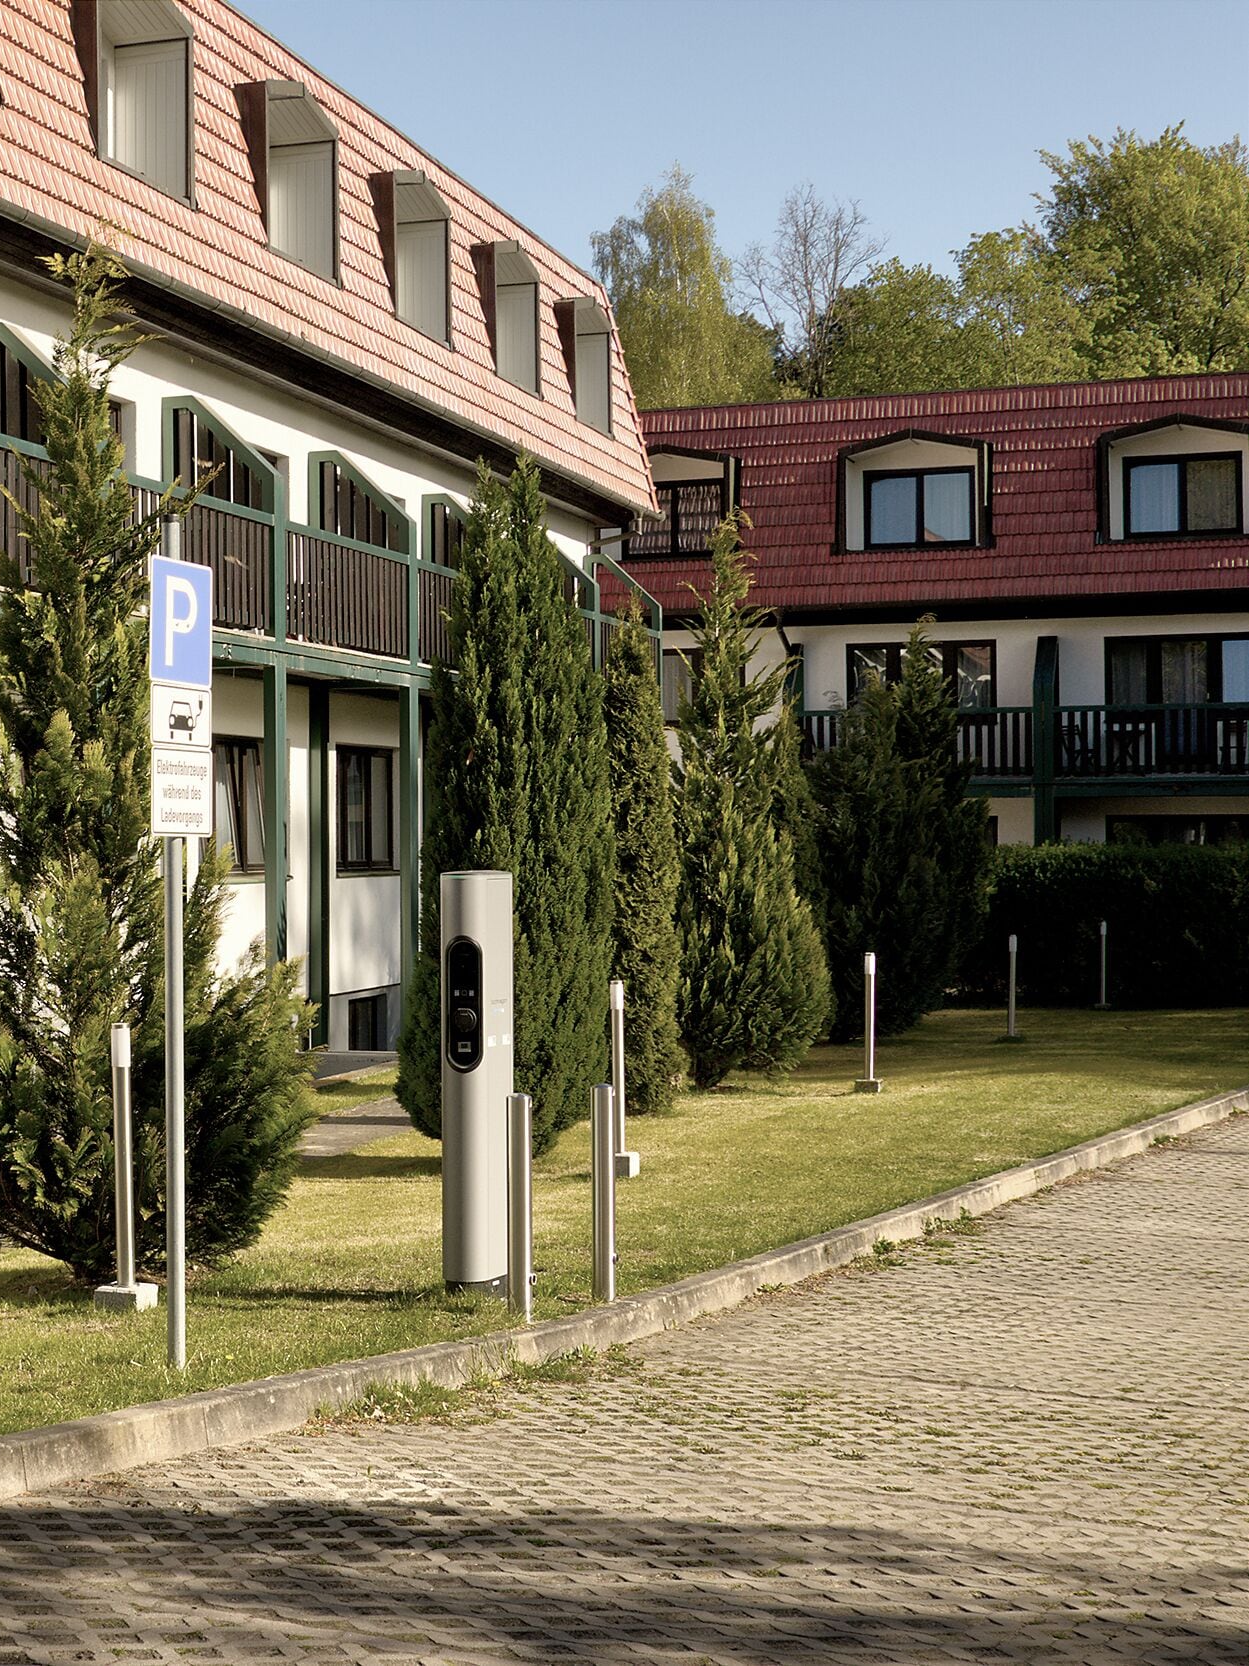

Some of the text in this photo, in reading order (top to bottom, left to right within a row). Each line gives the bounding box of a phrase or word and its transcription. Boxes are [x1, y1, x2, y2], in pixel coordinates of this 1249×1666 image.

[165, 575, 198, 667] P
[157, 759, 207, 780] Elektrofahrzeuge
[163, 784, 202, 800] während des
[160, 807, 203, 828] Ladevorgangs
